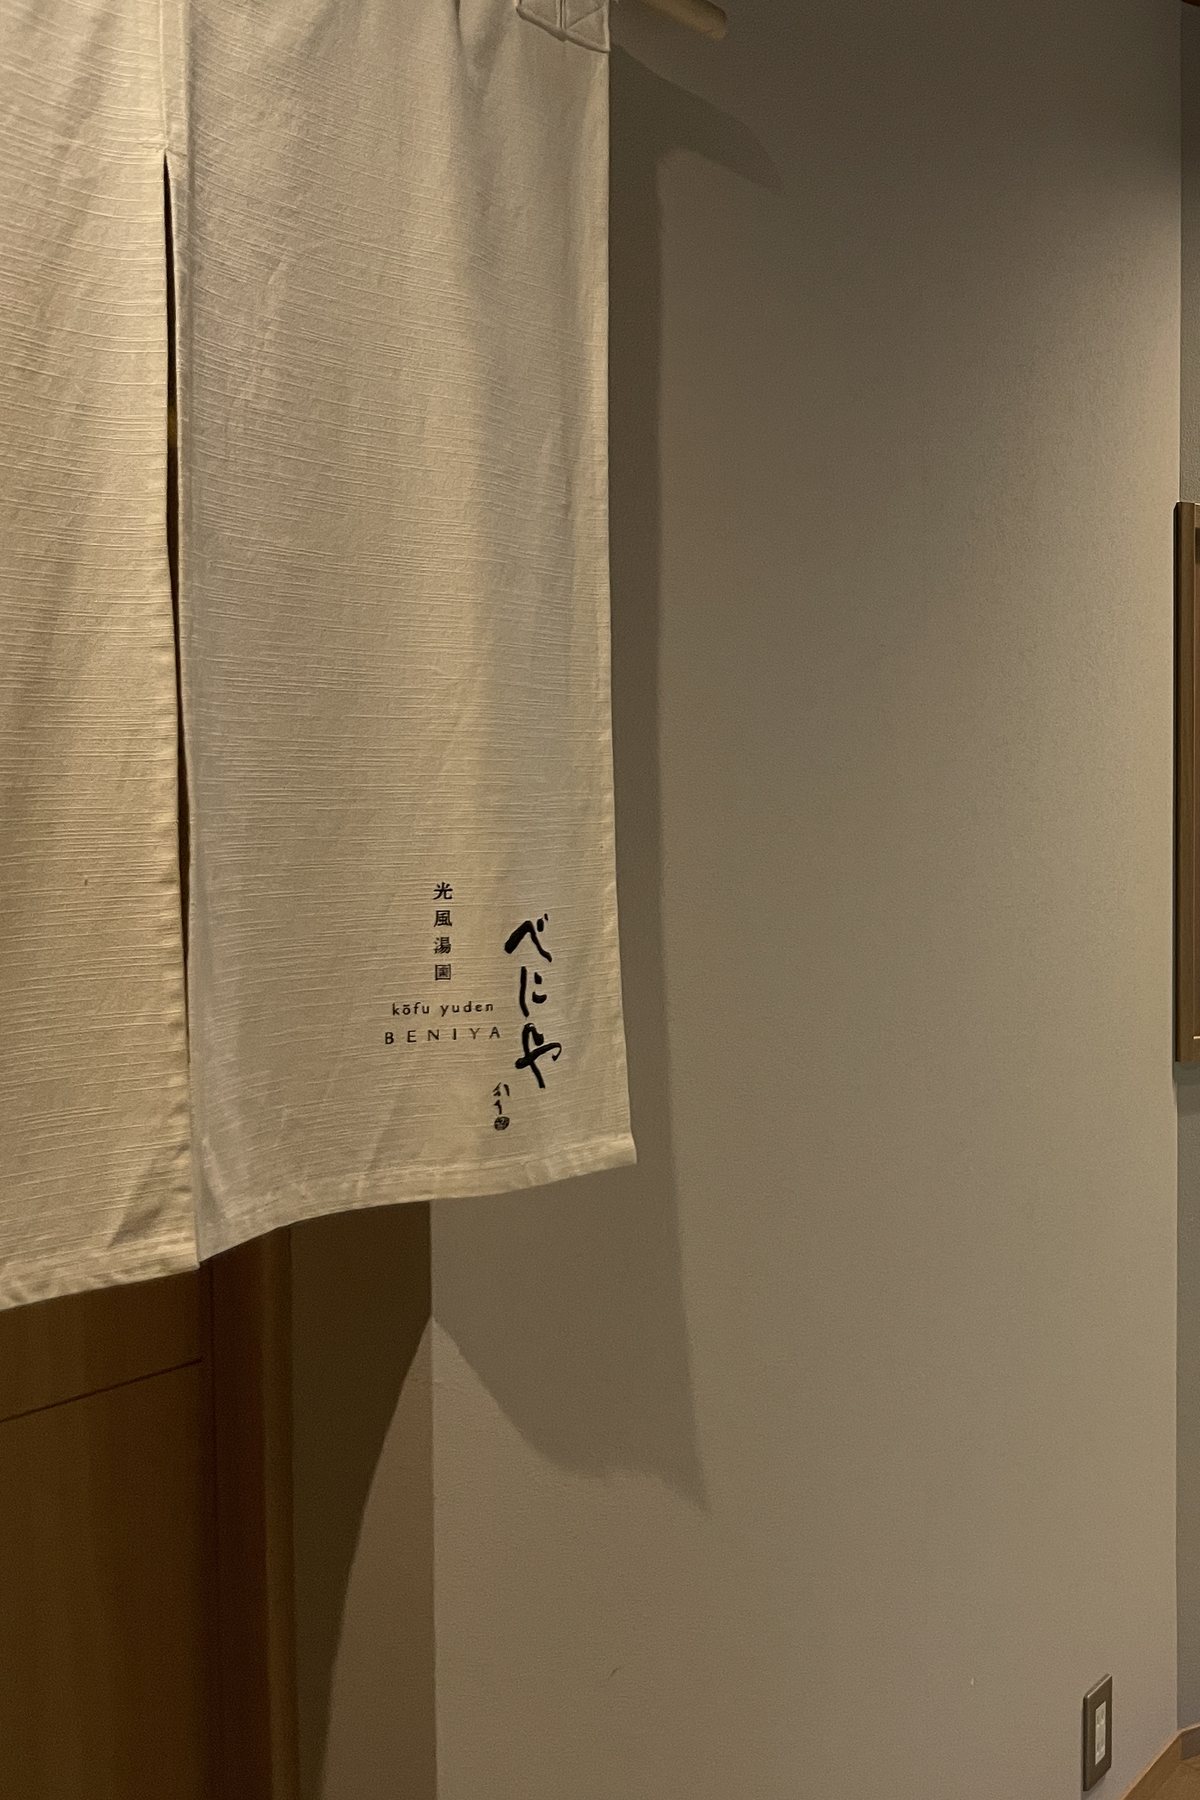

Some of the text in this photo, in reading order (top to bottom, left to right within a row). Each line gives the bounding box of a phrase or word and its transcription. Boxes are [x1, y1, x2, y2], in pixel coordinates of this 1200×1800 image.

[392, 1001, 494, 1017] kōfu yuden
[504, 913, 562, 1089] べにや
[384, 1026, 501, 1045] BENIYA
